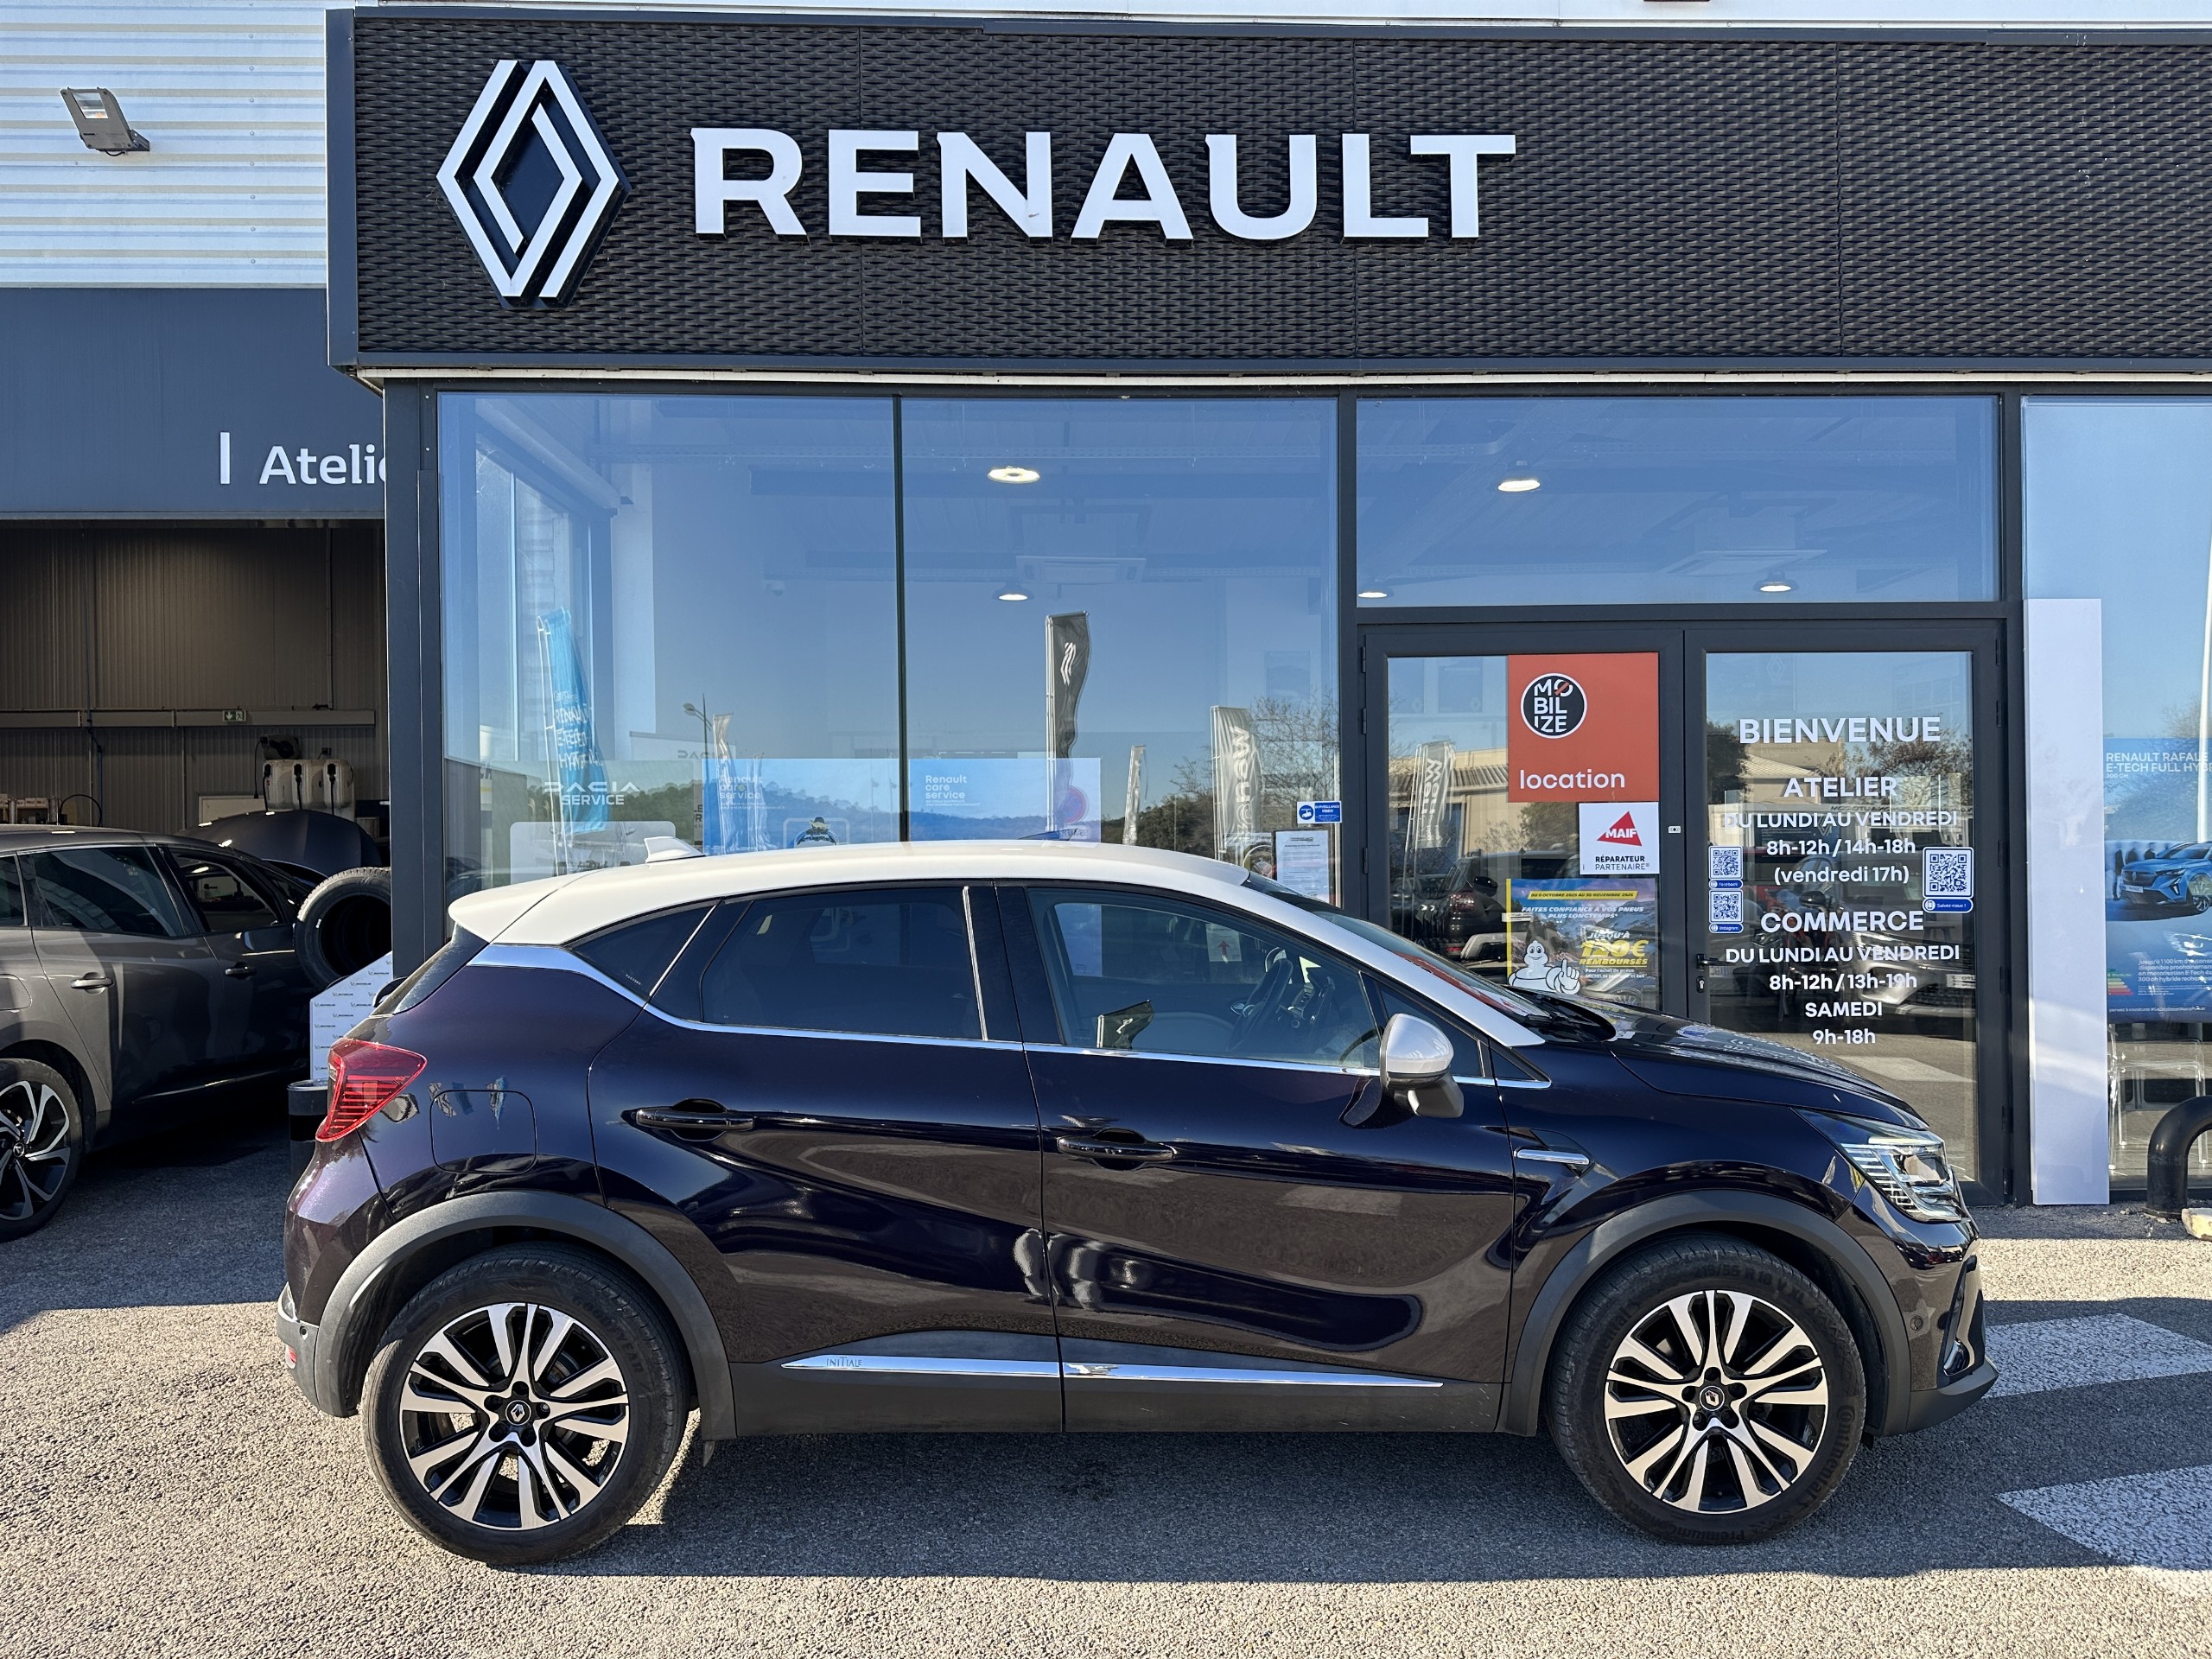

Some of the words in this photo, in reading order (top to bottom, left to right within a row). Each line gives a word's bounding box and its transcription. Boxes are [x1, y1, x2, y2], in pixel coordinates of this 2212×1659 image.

[690, 127, 1518, 241] RENAULT
[259, 443, 385, 485] Ateli
[1738, 715, 1941, 745] BIENVENUE
[2106, 752, 2160, 762] RENAULT
[2106, 762, 2149, 772] E-TECH
[2151, 762, 2182, 772] FULL
[925, 774, 968, 784] Renault
[1519, 768, 1626, 790] location
[1783, 776, 1897, 798] ATELIER
[561, 794, 625, 805] SERVICE
[925, 790, 966, 799] service
[1725, 812, 1752, 829] DU
[1756, 811, 1821, 829] LUNDI
[1822, 811, 1851, 828] AU
[1854, 810, 1958, 828] VENDREDI
[1605, 828, 1637, 839] MAIF
[1766, 839, 1831, 857] 8h-12h
[1846, 838, 1916, 855] 14h-18h
[1773, 866, 1870, 887] (vendredi
[1871, 865, 1910, 885] 17h)
[1759, 910, 1924, 933] COMMERCE
[1579, 957, 1649, 965] REMBOURSÉS
[1725, 947, 1756, 963] DU
[1758, 947, 1821, 963] LUNDI
[1823, 946, 1853, 963] AU
[1857, 945, 1960, 962] VENDREDI
[1769, 974, 1833, 992] 8h-12h
[1847, 972, 1918, 989] 13h-19h
[1804, 1001, 1884, 1019] SAMEDI
[1812, 1028, 1877, 1046] 9h-18h
[825, 1356, 863, 1369] INITIALE
[1805, 1404, 1855, 1501] Continental
